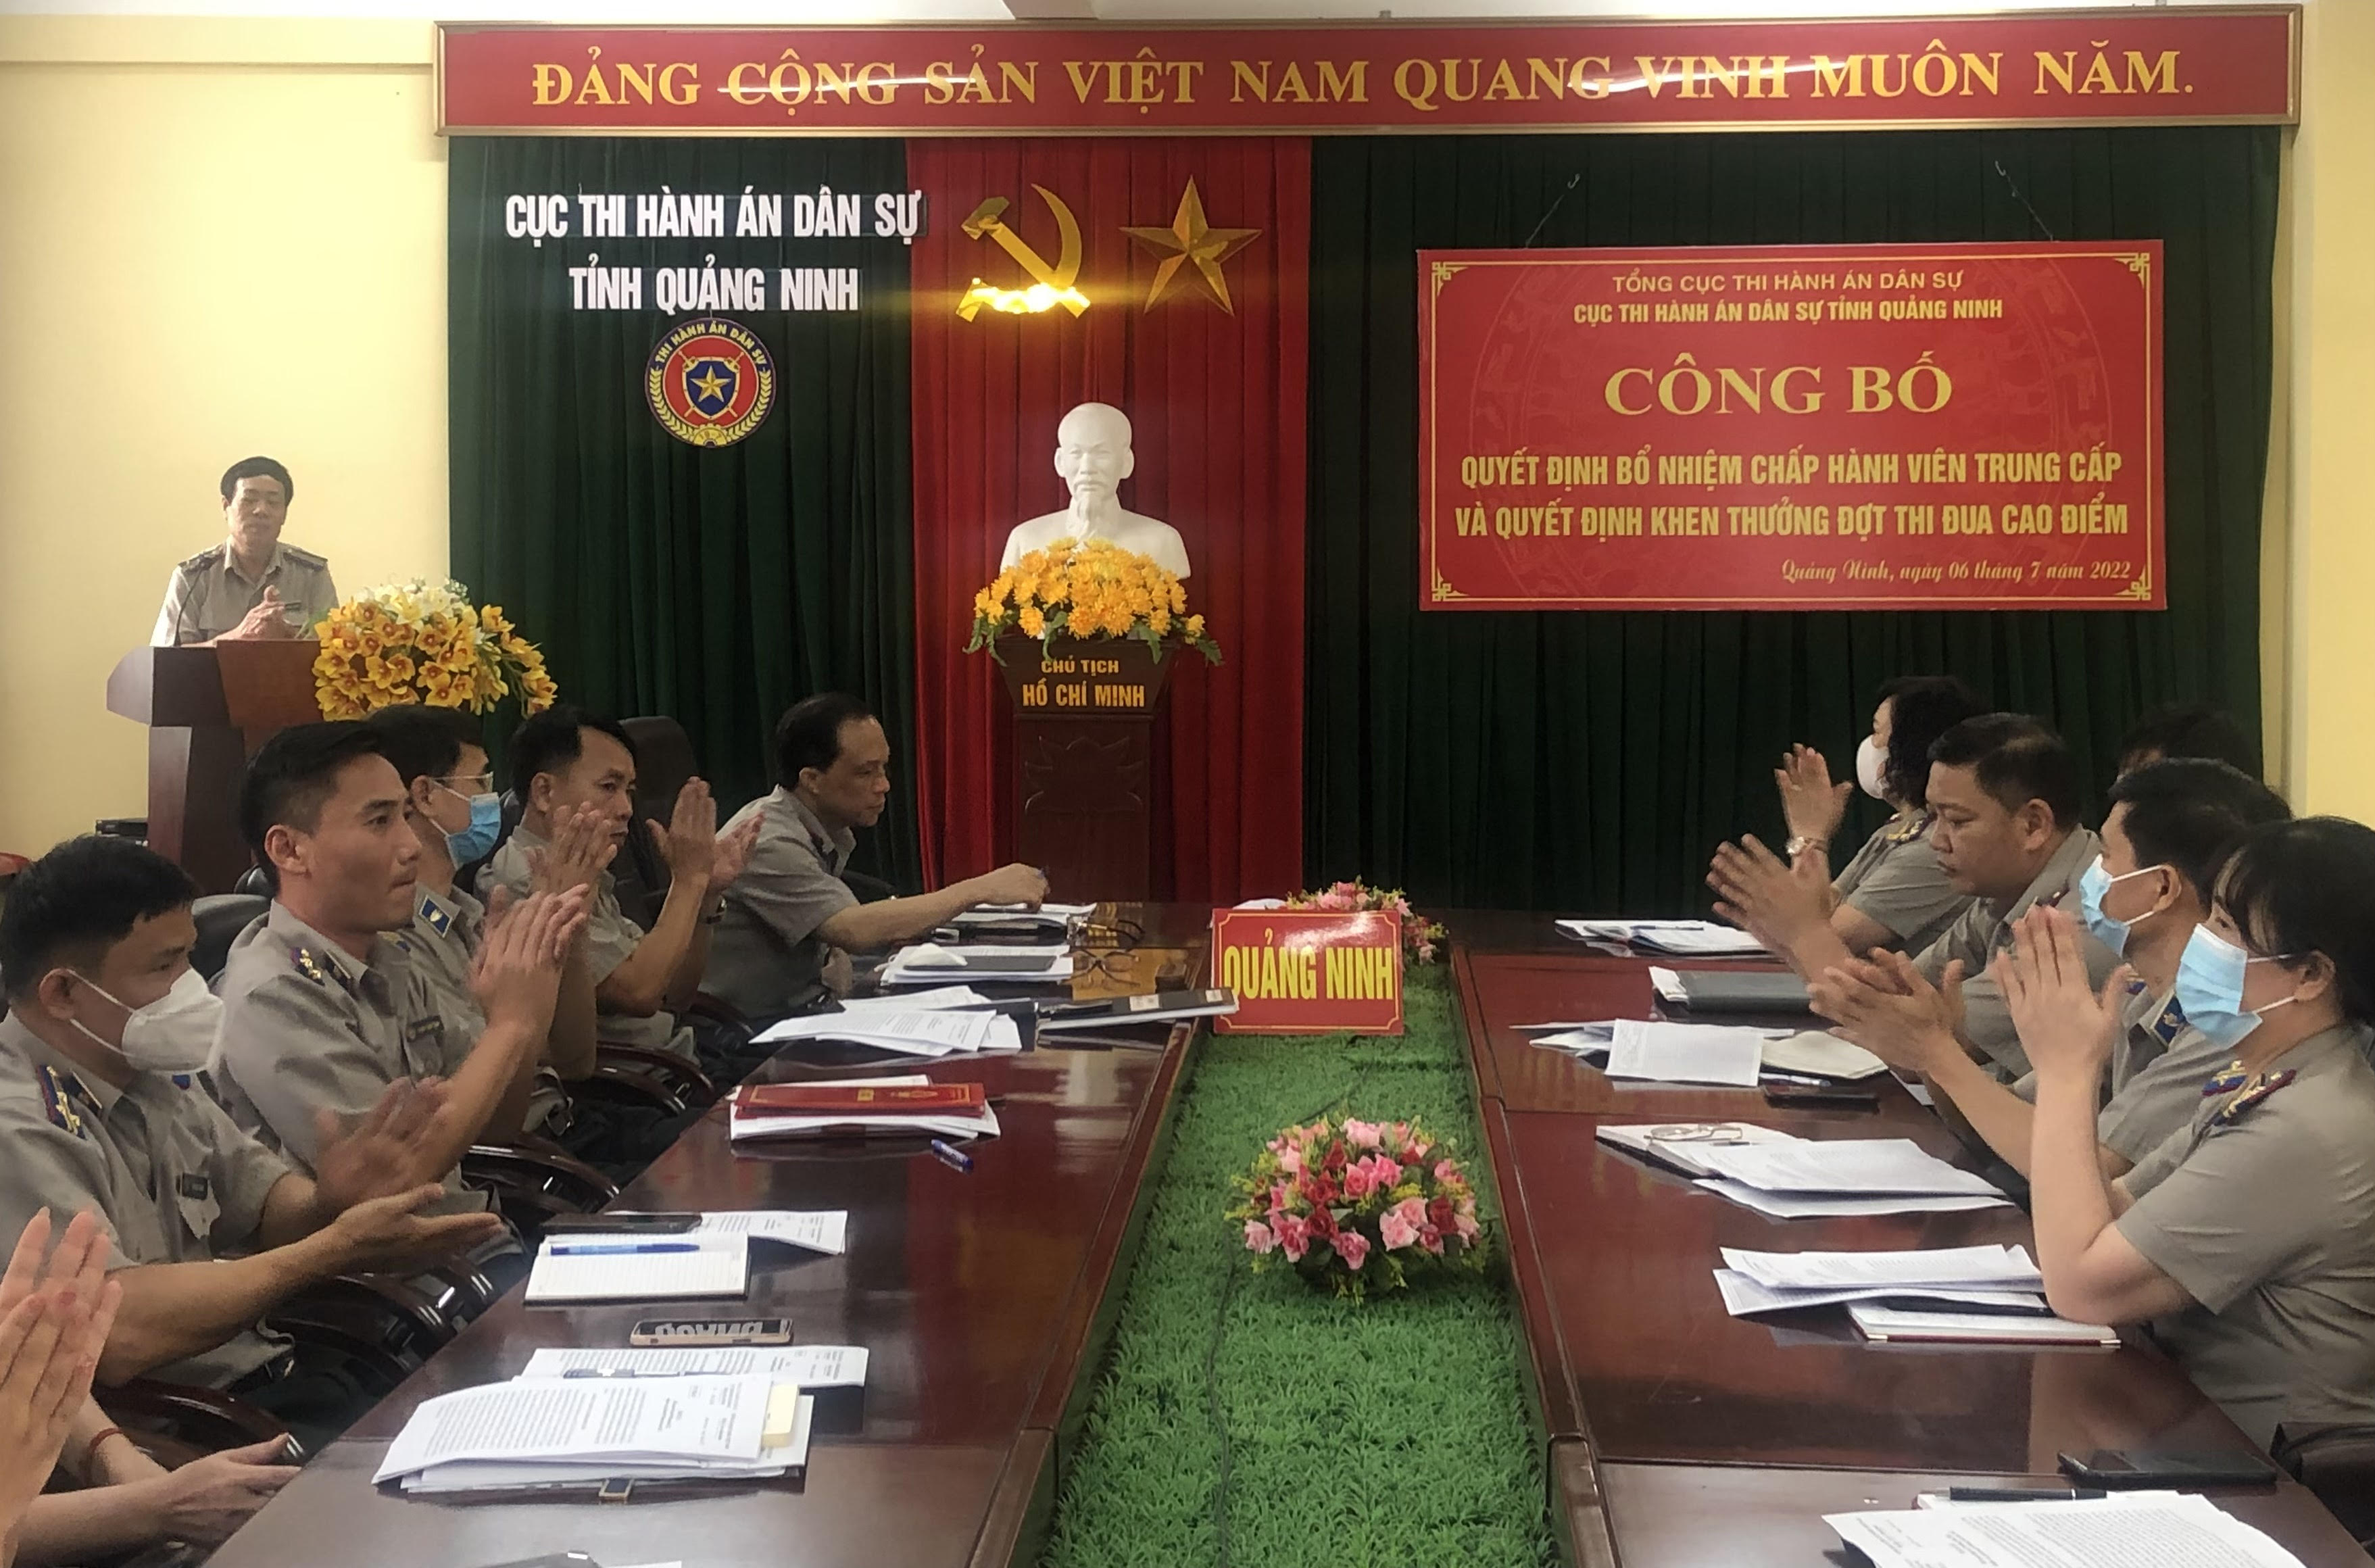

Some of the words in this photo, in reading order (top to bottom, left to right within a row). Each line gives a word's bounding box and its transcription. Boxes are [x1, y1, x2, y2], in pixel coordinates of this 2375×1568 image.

[533, 46, 701, 105] ĐẢNG
[727, 48, 900, 116] CỘNG
[924, 44, 1039, 106] SẢN
[1064, 47, 1204, 114] VIỆT
[1231, 59, 1369, 103] NAM
[1393, 55, 1615, 112] QUANG
[1636, 54, 1791, 101] VINH
[1810, 39, 2003, 97] MUÔN
[2033, 39, 2195, 96] NĂM.
[506, 195, 568, 247] CỤC
[578, 194, 626, 237] THI
[637, 186, 724, 237] HÀNH
[735, 185, 781, 237] ÁN
[794, 185, 860, 237] DÂN
[875, 190, 922, 244] SỰ
[569, 253, 641, 310] TỈNH
[656, 254, 764, 316] QUẢNG
[779, 268, 858, 310] NINH
[1613, 266, 1673, 292] TỔNG
[1680, 275, 1726, 295] CỤC
[1732, 274, 1767, 291] THI
[1774, 269, 1835, 291] HÀNH
[1841, 270, 1873, 291] ÁN
[1880, 268, 1925, 290] DÂN
[1932, 270, 1963, 291] SỰ
[1574, 303, 1612, 326] CỤC
[1619, 303, 1648, 322] THI
[1655, 298, 1709, 322] HÀNH
[1715, 299, 1743, 322] ÁN
[1748, 298, 1790, 321] DÂN
[1795, 299, 1824, 324] SỰ
[1828, 294, 1873, 320] TỈNH
[1879, 295, 1946, 322] QUẢNG
[1953, 299, 2003, 318] NINH
[655, 343, 672, 362] THI
[1605, 352, 1826, 415] CÔNG
[1846, 351, 1952, 414] BỐ
[1462, 447, 1539, 487] QUYẾT
[1546, 456, 1608, 491] ĐỊNH
[1617, 444, 1651, 485] BỔ
[1659, 449, 1743, 491] NHIỆM
[1750, 444, 1819, 485] CHẤP
[1828, 448, 1899, 484] HÀNH
[1907, 447, 1966, 483] VIÊN
[1974, 452, 2060, 483] TRUNG
[2070, 441, 2122, 483] CẤP
[1456, 501, 1487, 536] VÀ
[1496, 498, 1574, 539] QUYẾT
[1581, 507, 1642, 542] ĐỊNH
[1651, 506, 1719, 535] KHEN
[1727, 496, 1830, 536] THƯỞNG
[1837, 503, 1887, 541] ĐỢT
[1894, 506, 1934, 535] THI
[1942, 505, 1993, 535] ĐUA
[2002, 504, 2053, 534] CAO
[2061, 493, 2128, 534] ĐIỂM
[1901, 566, 1942, 584] ngày
[1949, 562, 1969, 579] 06
[1974, 560, 2023, 583] tháng
[2031, 562, 2041, 579] 7
[2047, 563, 2084, 579] năm
[2090, 562, 2131, 579] 2022
[1081, 660, 1119, 676] TỊCH
[1056, 680, 1087, 706] CHÍ
[1095, 685, 1144, 707] MINH
[1224, 927, 1317, 1000] QUẢNG
[1325, 946, 1393, 1000] NINH
